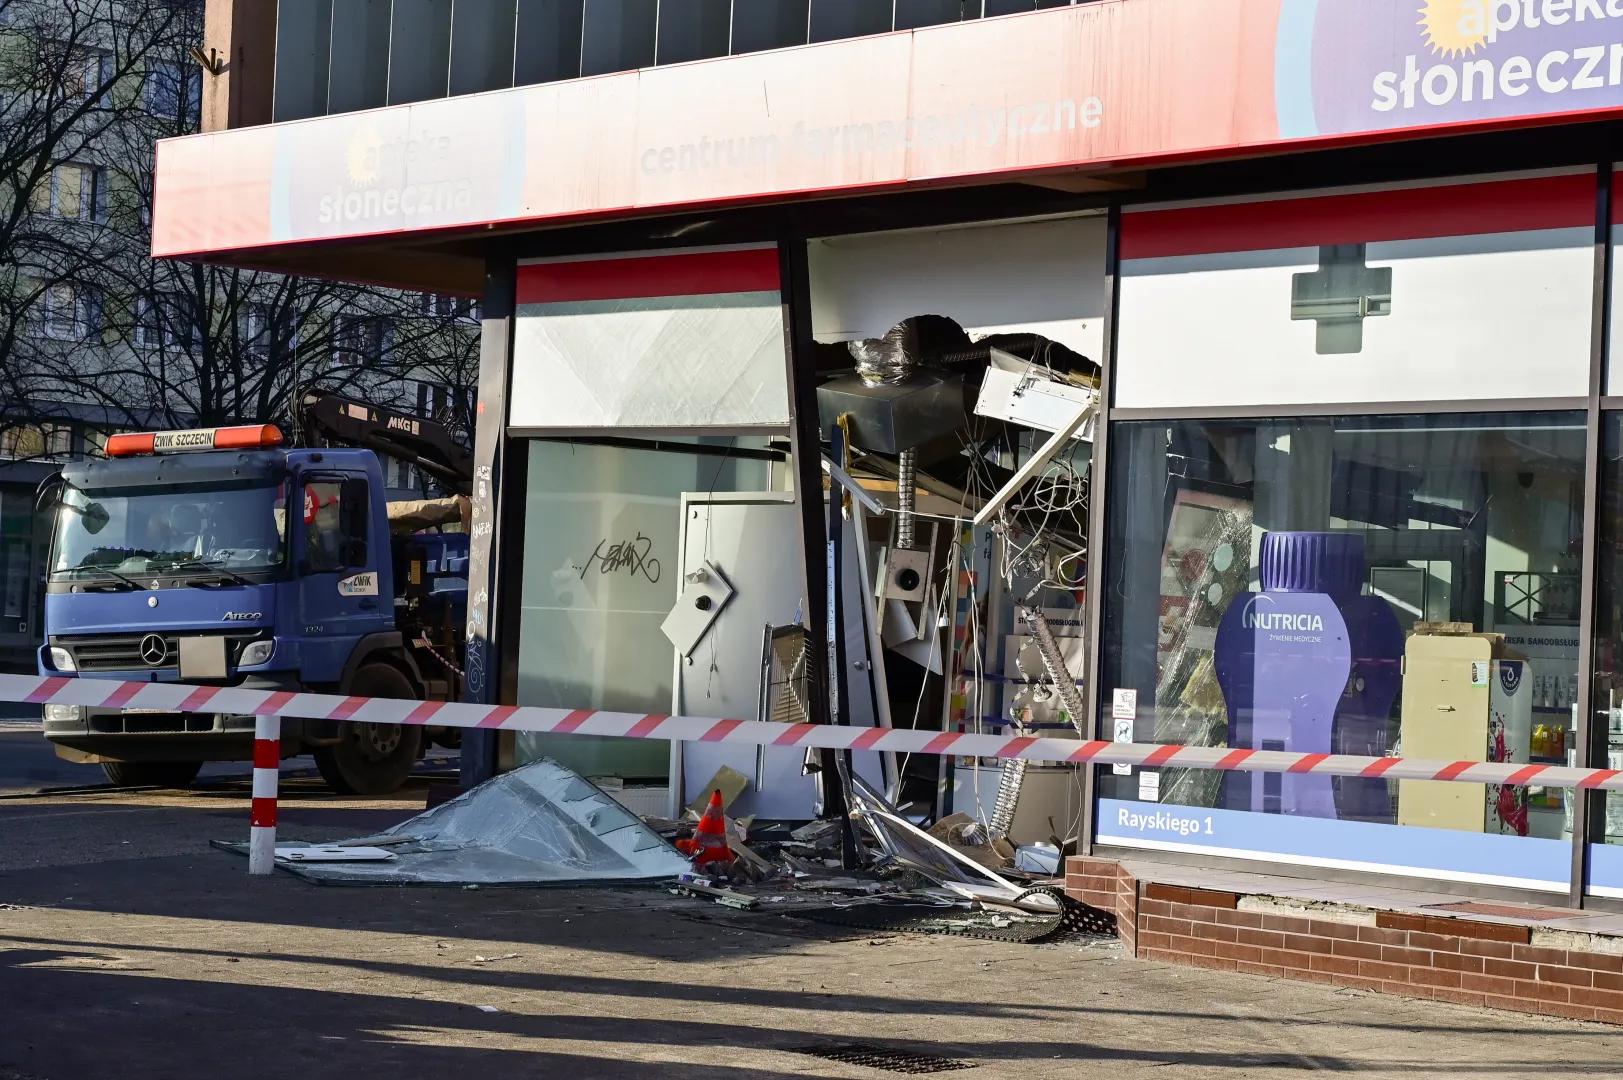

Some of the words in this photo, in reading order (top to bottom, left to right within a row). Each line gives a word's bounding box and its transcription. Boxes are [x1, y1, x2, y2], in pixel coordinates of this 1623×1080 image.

[641, 133, 779, 176] centrum
[792, 96, 1103, 162] farmaceutyczne
[318, 176, 472, 224] słoneczna
[387, 416, 411, 432] MKG
[154, 435, 174, 448] ZWIK
[176, 432, 213, 446] SZCZECIN
[1249, 613, 1324, 632] NUTRICIA
[1293, 635, 1322, 644] MEDYCZNE
[1118, 807, 1200, 836] Rayskiego
[1204, 816, 1214, 835] 1
